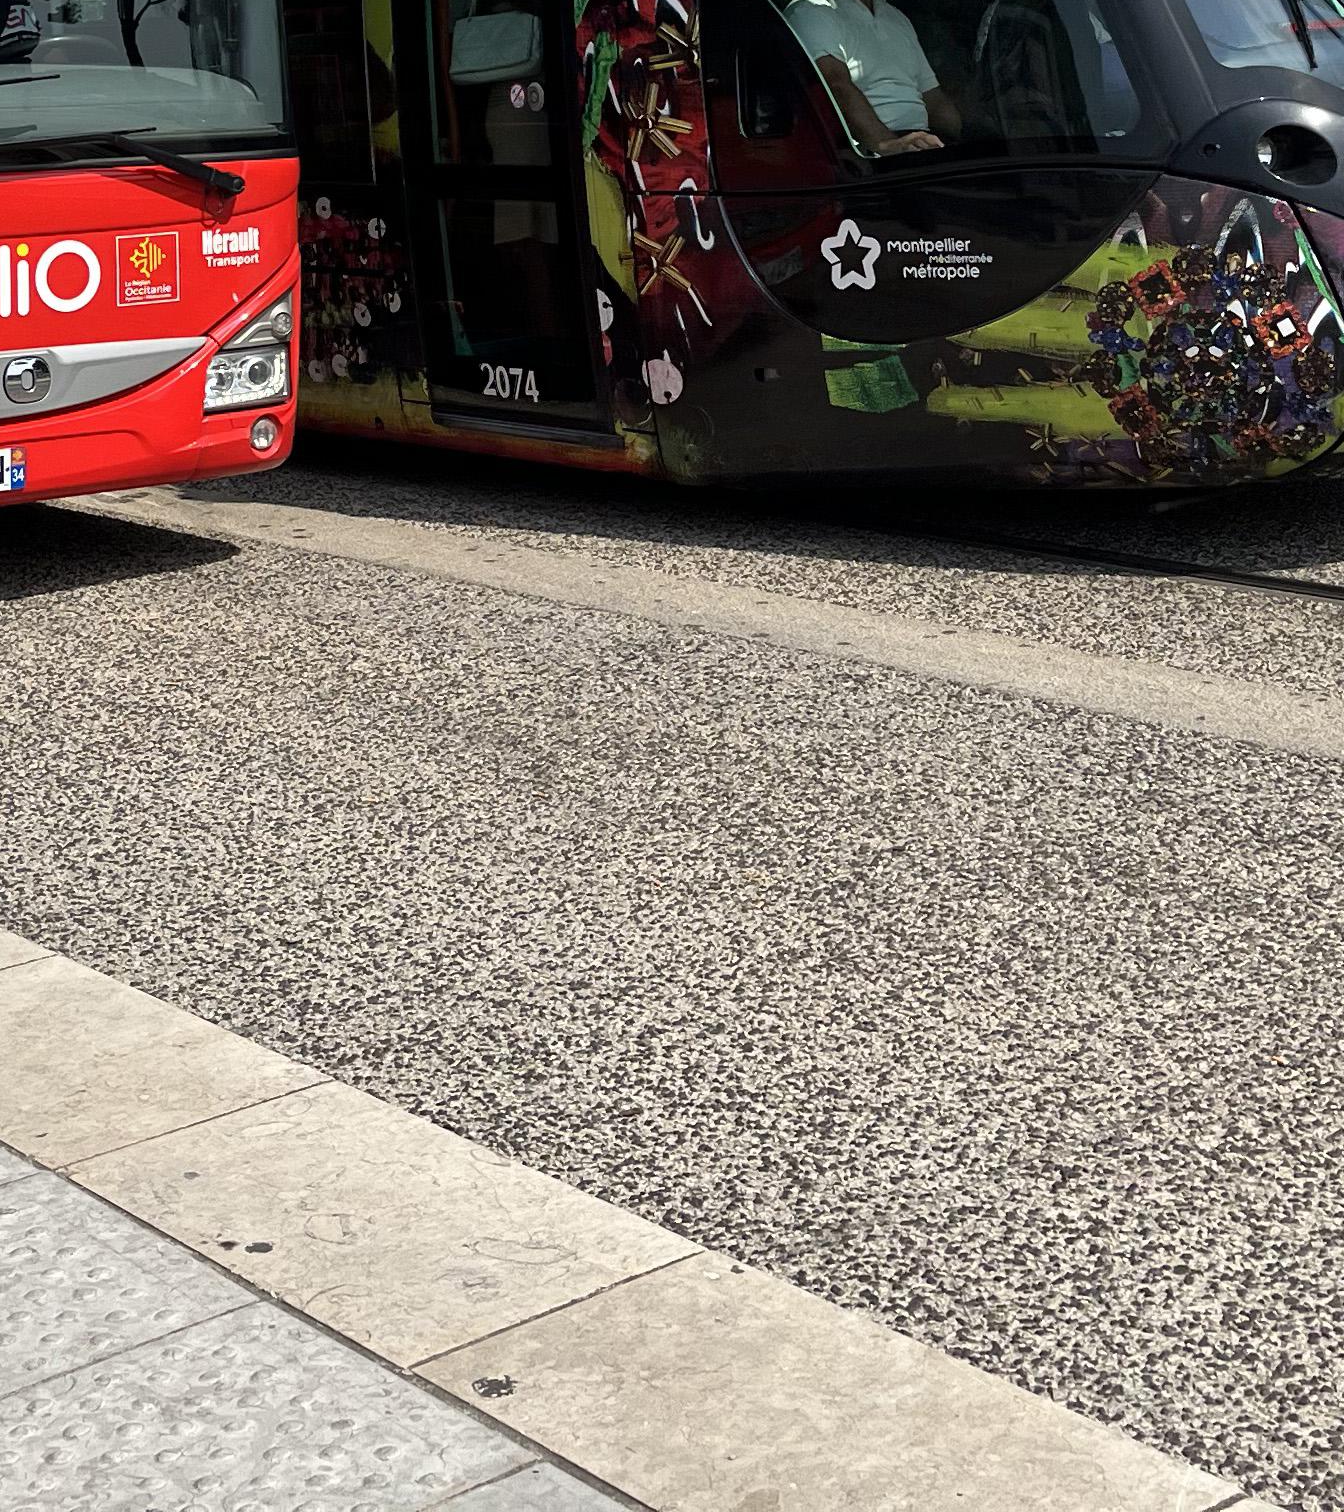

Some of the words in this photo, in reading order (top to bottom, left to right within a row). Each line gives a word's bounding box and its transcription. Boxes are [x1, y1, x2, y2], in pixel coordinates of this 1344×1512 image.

[202, 227, 260, 255] Hérault
[206, 253, 259, 267] Transport
[903, 263, 980, 281] Métropole
[125, 284, 172, 297] Occitanie
[479, 362, 540, 403] 2074
[11, 469, 25, 482] 34
